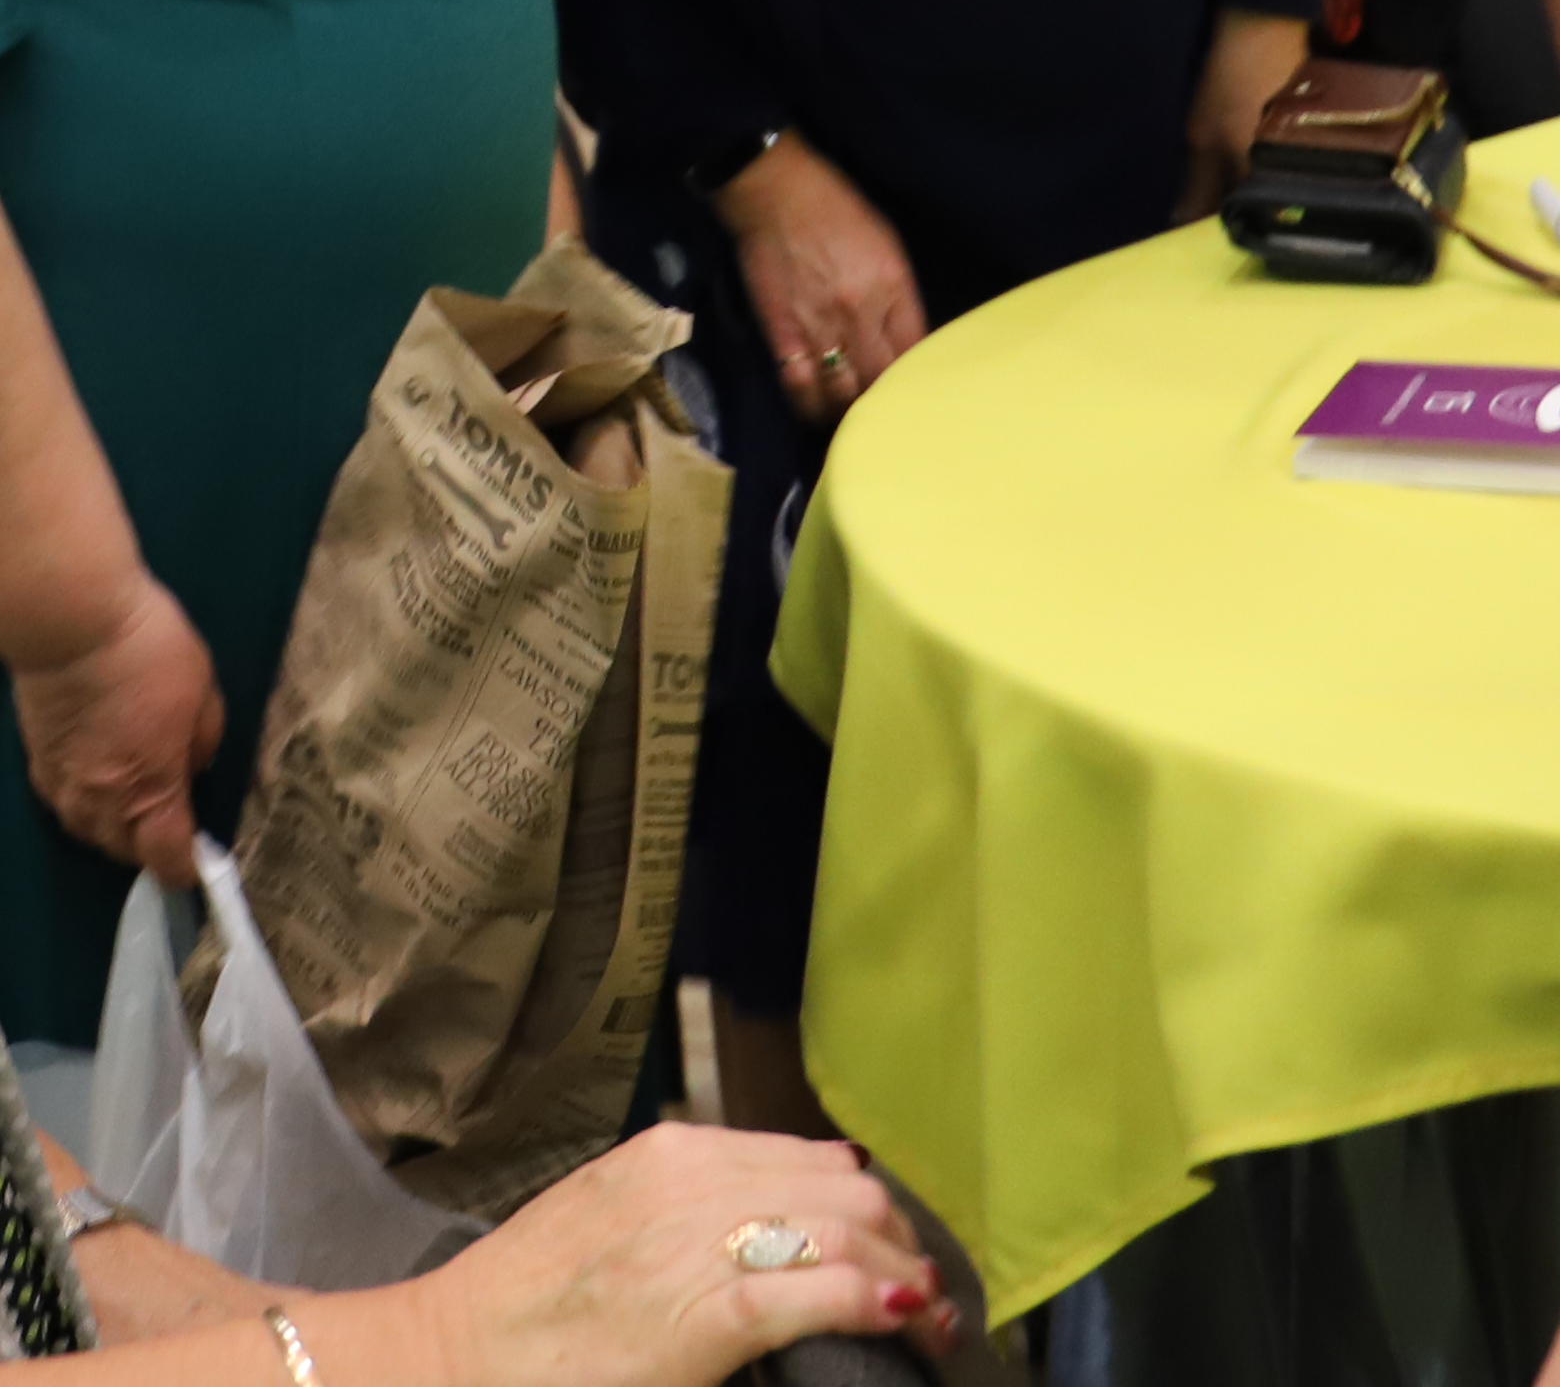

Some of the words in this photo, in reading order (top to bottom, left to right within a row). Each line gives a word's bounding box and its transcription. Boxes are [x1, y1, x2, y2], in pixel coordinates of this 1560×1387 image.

[450, 387, 554, 511] TOM'S
[500, 655, 580, 729] LAWSON
[474, 730, 519, 772] FOR
